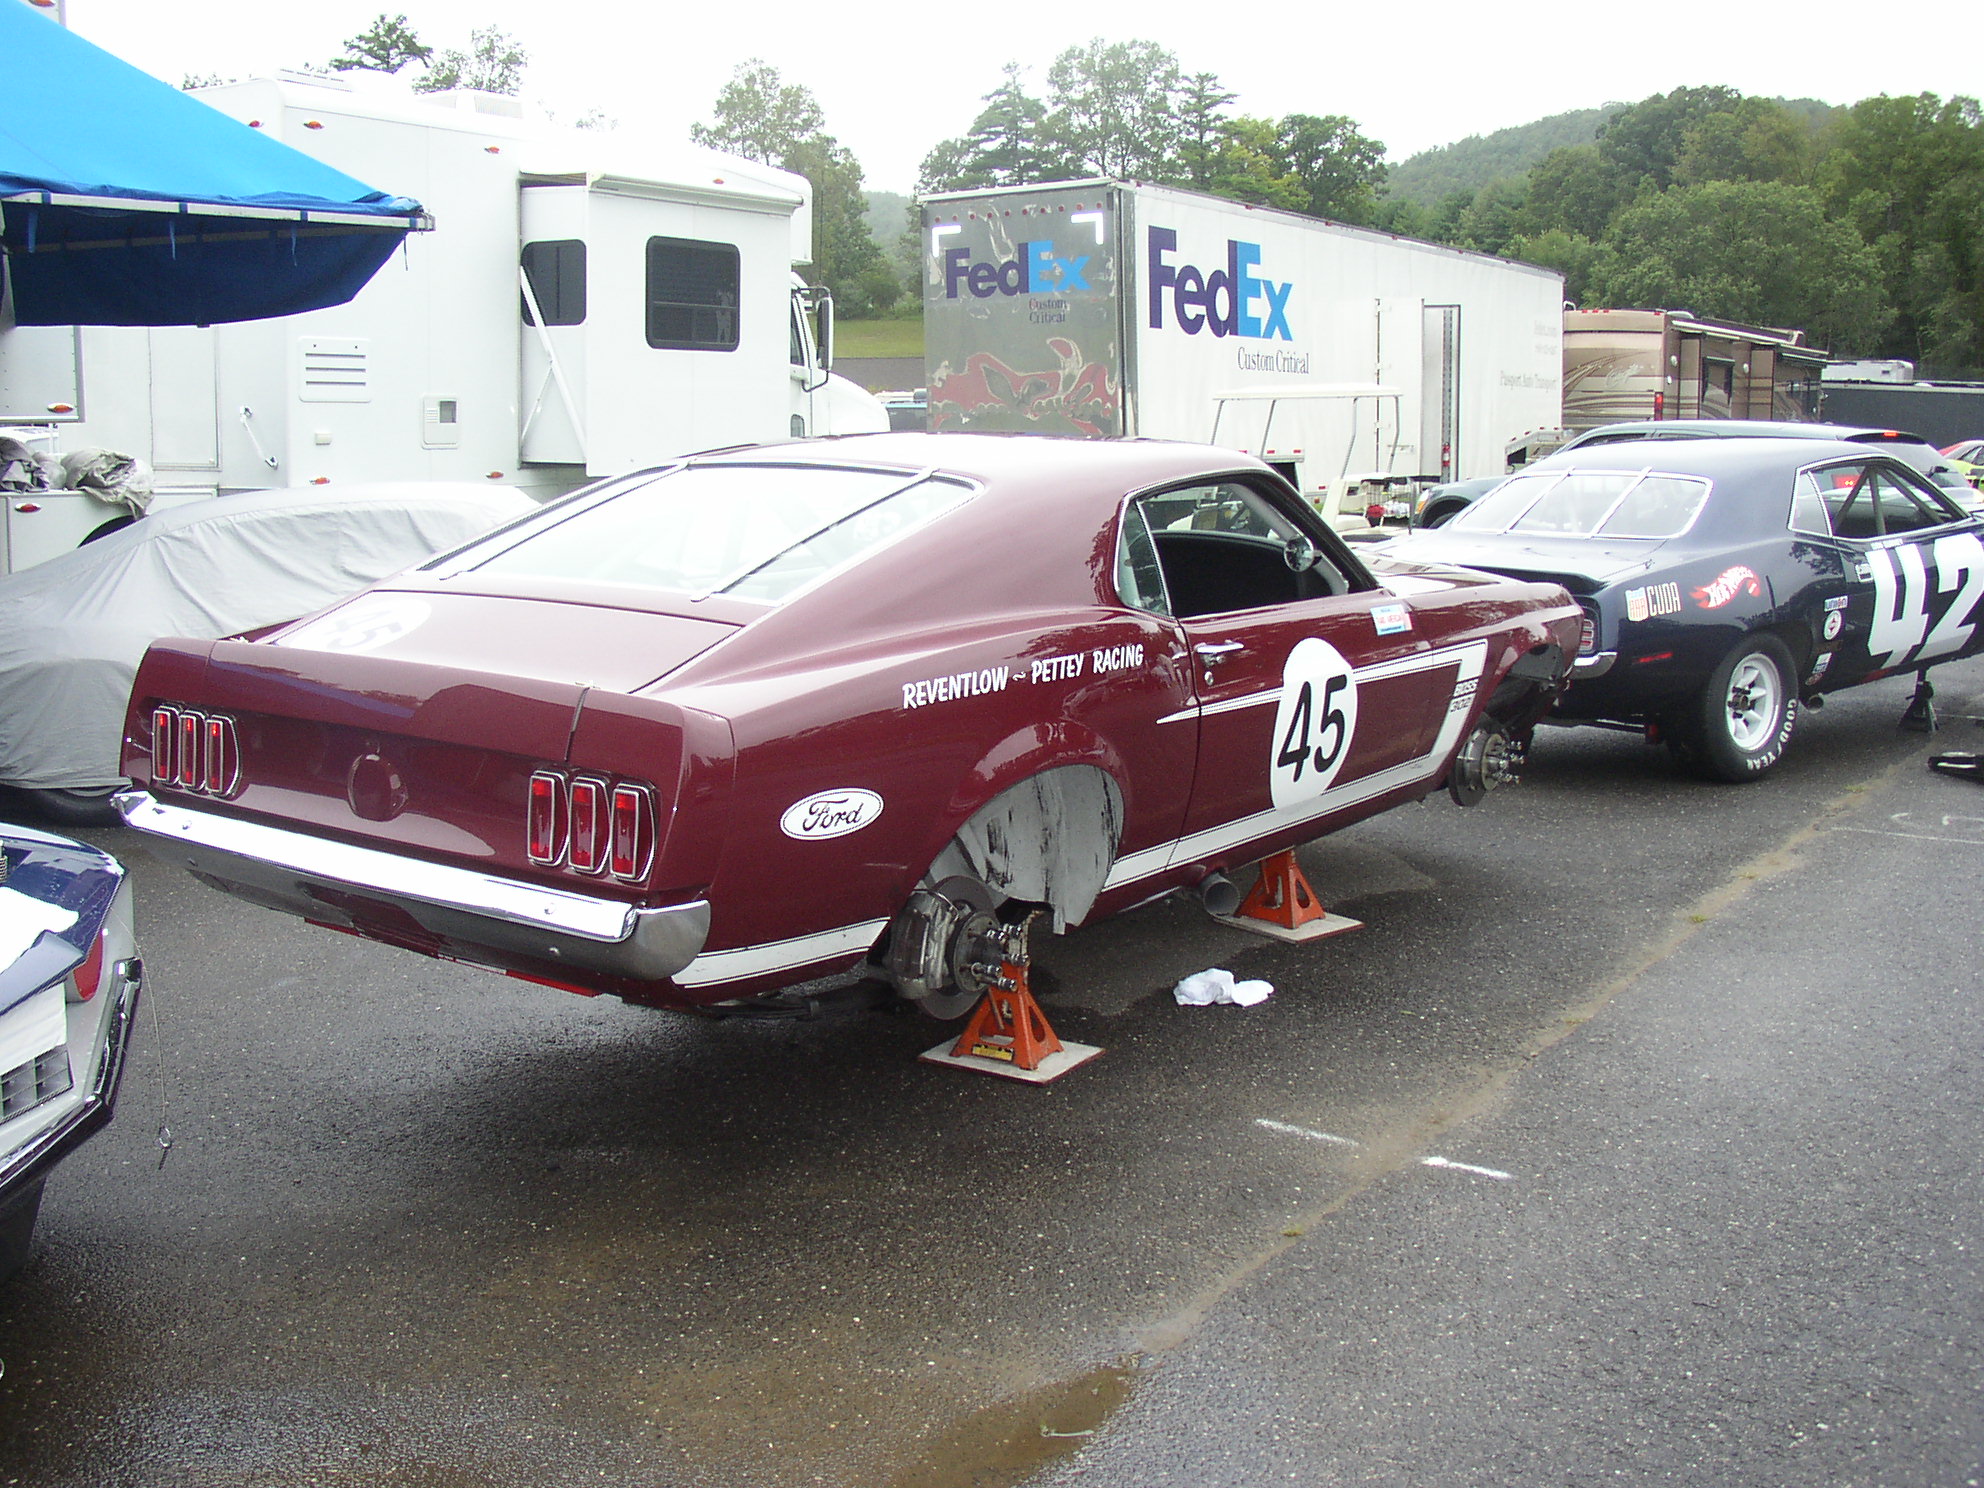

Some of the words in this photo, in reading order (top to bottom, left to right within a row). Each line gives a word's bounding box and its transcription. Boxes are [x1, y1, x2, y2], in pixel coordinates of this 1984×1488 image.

[945, 240, 1091, 298] FedEx
[1148, 225, 1293, 342] FedEx
[1028, 297, 1068, 311] Custom
[1029, 311, 1066, 324] Critical
[1237, 346, 1275, 373] Custom
[1275, 348, 1310, 375] Critical
[1646, 581, 1682, 617] CUDA
[1702, 581, 1731, 608] HOT
[1865, 532, 1984, 670] 42
[902, 667, 1010, 710] REVENTLOW
[1031, 653, 1085, 684] PETTEY
[1093, 644, 1143, 674] RACING
[1276, 673, 1348, 783] 45
[803, 798, 862, 831] Ford
